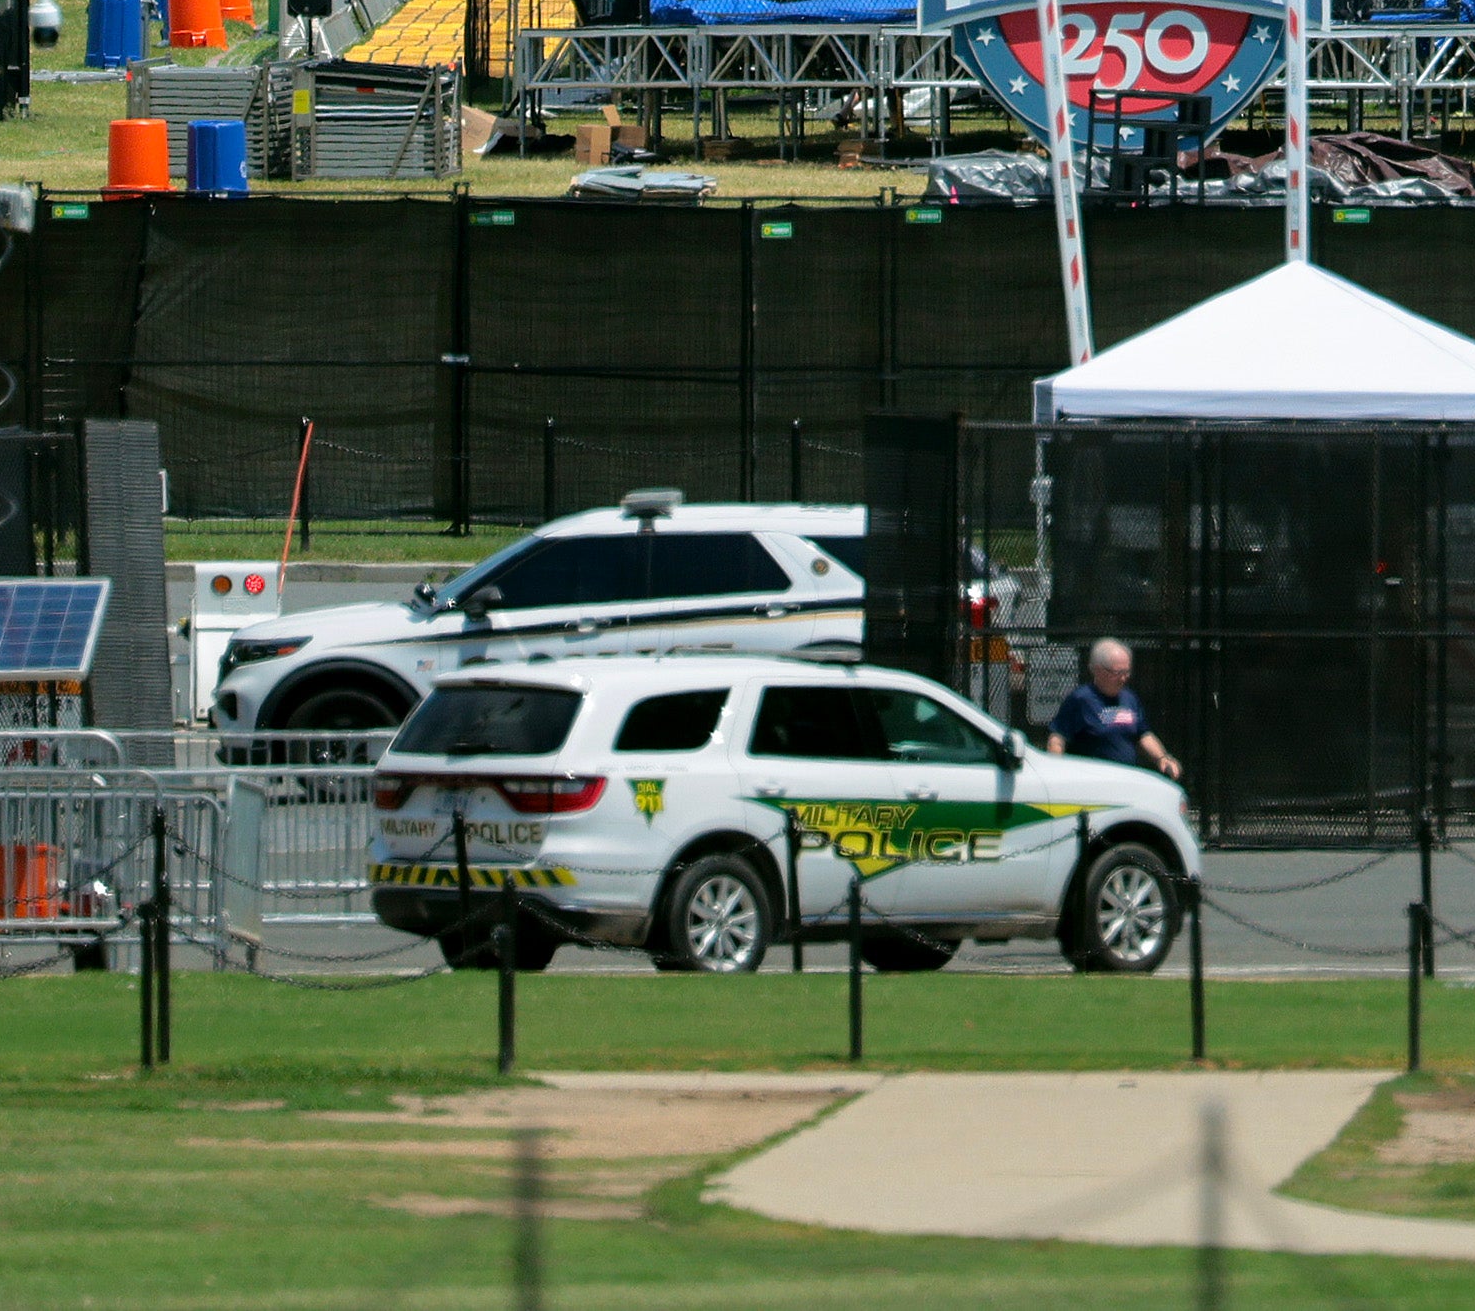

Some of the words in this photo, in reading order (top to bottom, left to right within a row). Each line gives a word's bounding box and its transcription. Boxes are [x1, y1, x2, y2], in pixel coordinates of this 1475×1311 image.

[1058, 9, 1210, 99] 250
[637, 782, 658, 794] DIAL
[635, 794, 664, 812] 911
[380, 818, 437, 835] MILITARY
[791, 803, 918, 829] MILITARY
[465, 821, 543, 845] POLICE
[795, 829, 1006, 862] POLICE
